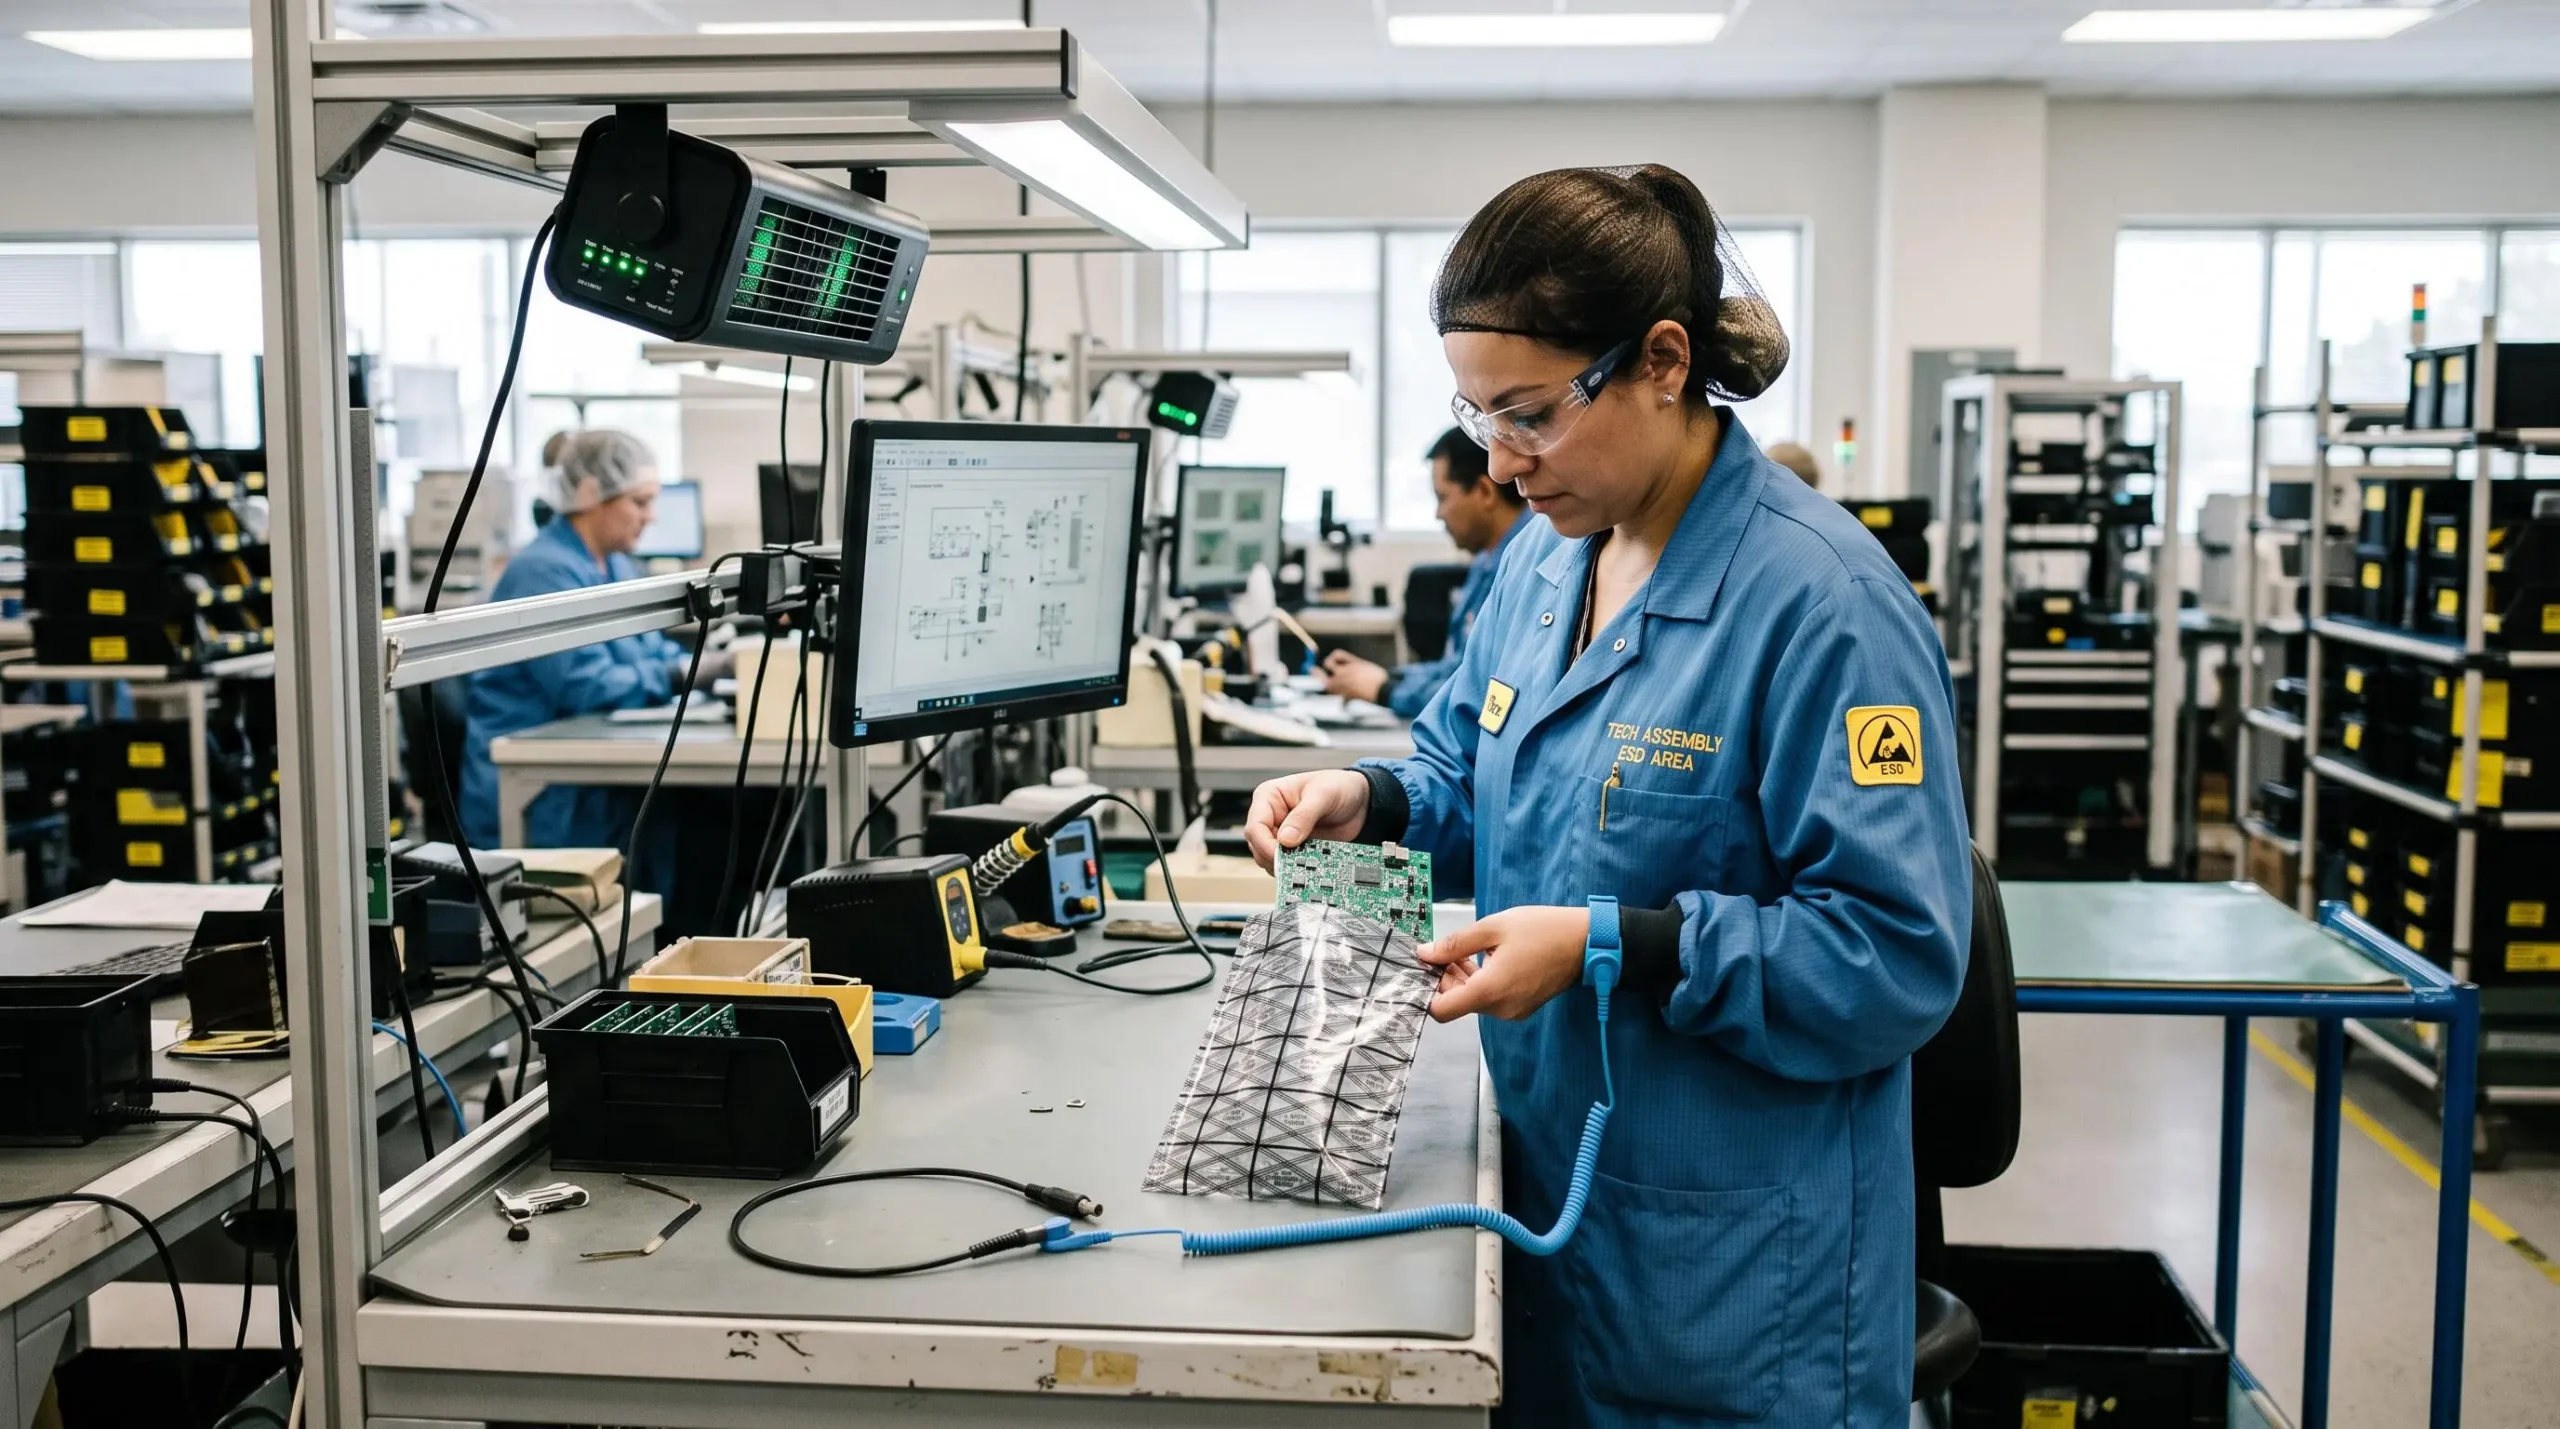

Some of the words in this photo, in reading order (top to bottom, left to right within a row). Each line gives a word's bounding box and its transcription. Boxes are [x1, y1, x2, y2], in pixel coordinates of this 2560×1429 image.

[1607, 722, 1640, 741] TECH
[1641, 726, 1723, 753] ASSEMBLY
[1617, 745, 1645, 763] ESD
[1650, 749, 1694, 771] AREA
[1880, 763, 1904, 775] ESD
